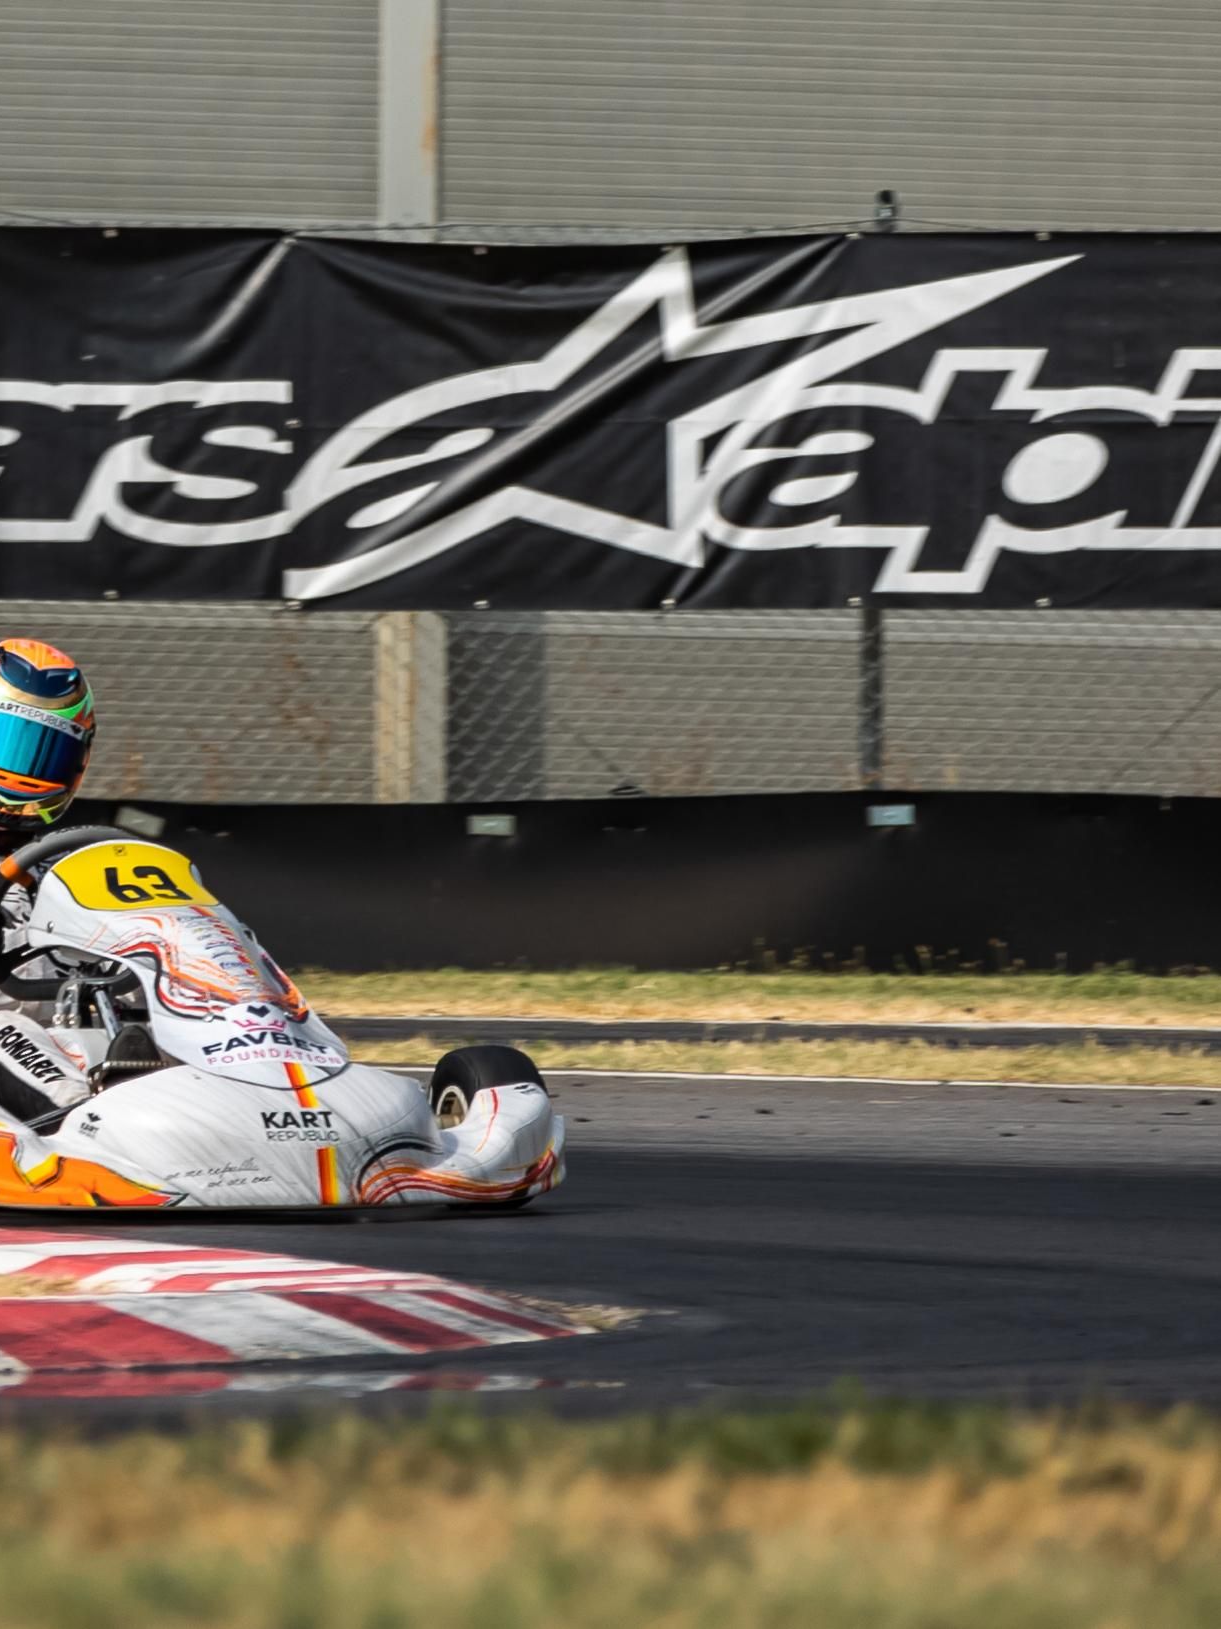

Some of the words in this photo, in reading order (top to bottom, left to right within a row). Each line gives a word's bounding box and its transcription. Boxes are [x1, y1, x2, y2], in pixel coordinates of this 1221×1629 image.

[104, 866, 194, 904] 63
[201, 1031, 329, 1056] FAVBET
[206, 1047, 343, 1066] FOUNDATION
[260, 1110, 333, 1129] KART
[266, 1130, 341, 1143] REPUBLIC
